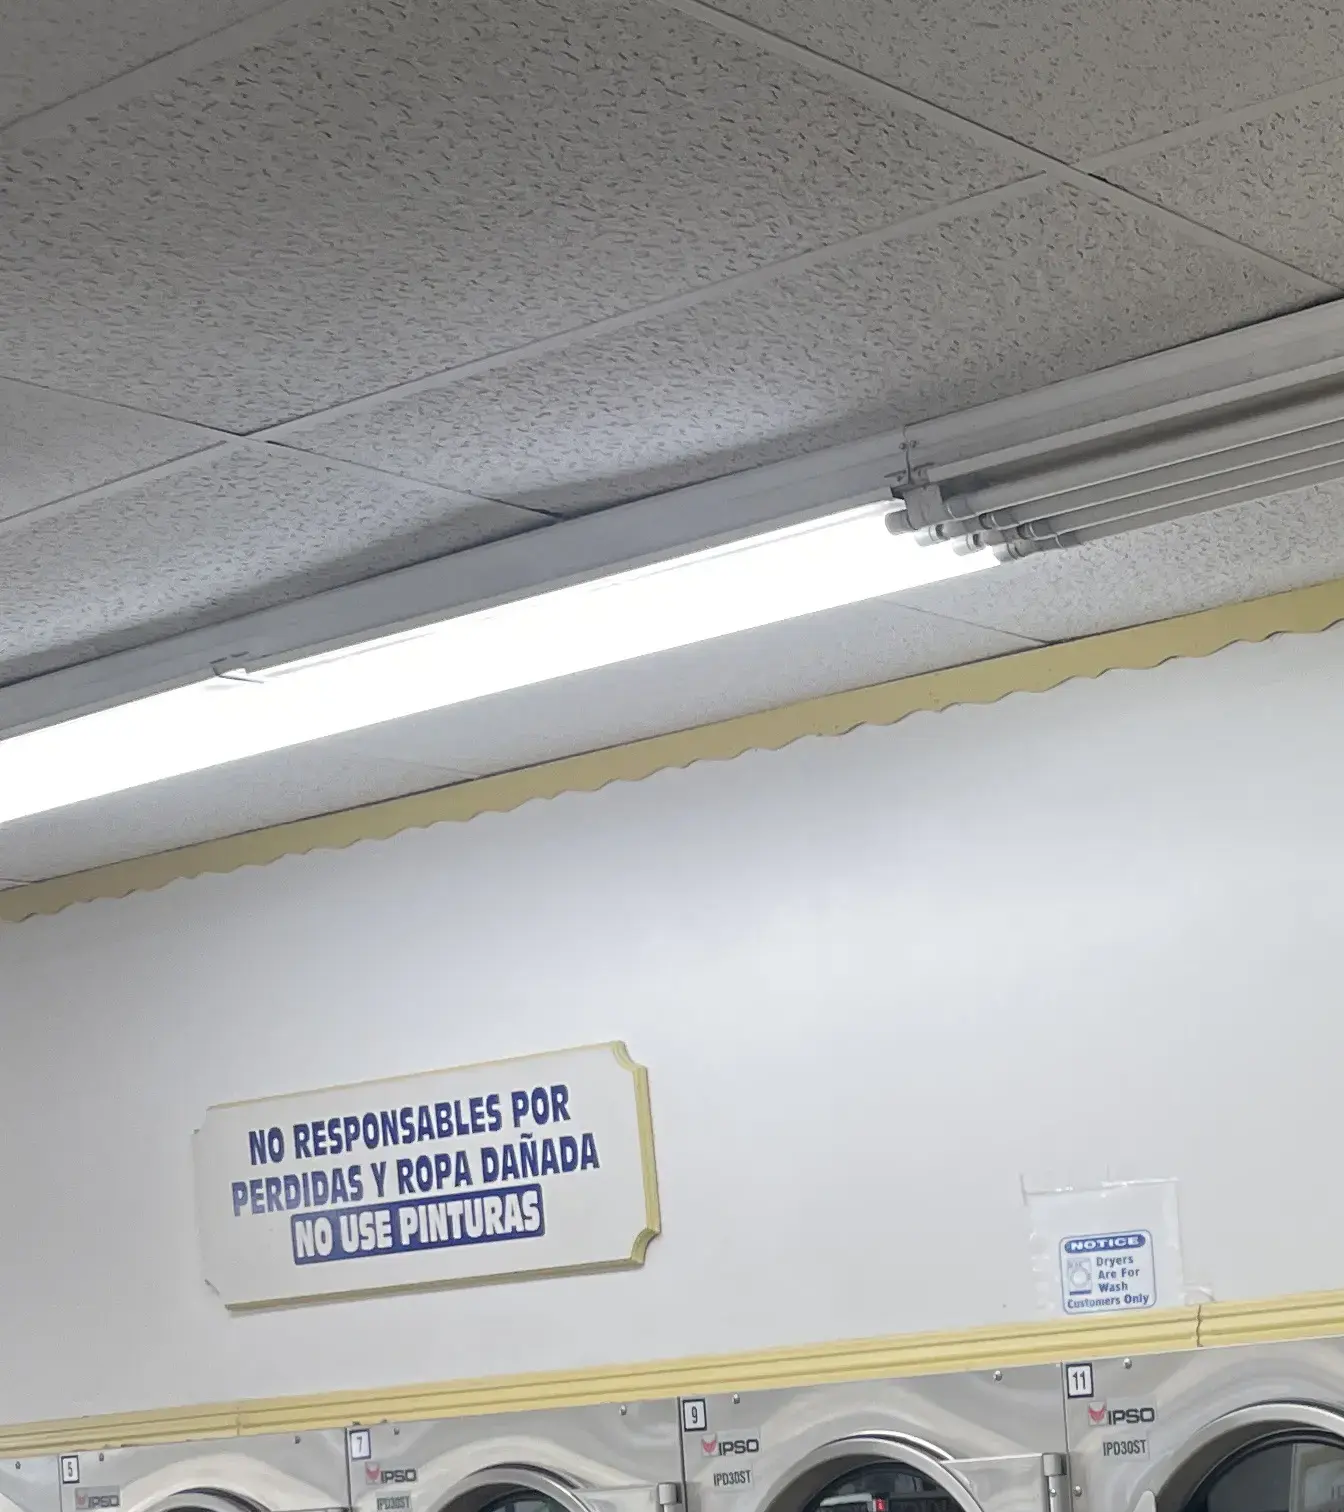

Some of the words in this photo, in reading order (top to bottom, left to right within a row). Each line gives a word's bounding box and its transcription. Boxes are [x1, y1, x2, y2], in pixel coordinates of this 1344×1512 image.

[248, 1127, 285, 1166] NO
[293, 1093, 501, 1160] RESPONSABLES
[510, 1084, 571, 1129] POR
[231, 1165, 364, 1217] PERDIDAS
[370, 1161, 388, 1198] Y
[396, 1148, 473, 1195] ROPA
[481, 1132, 600, 1184] DAÑADA
[296, 1219, 333, 1259] NO
[341, 1210, 393, 1253] USE
[400, 1191, 541, 1248] PINTURAS
[1070, 1236, 1140, 1251] NOTICE
[1096, 1255, 1134, 1268] Dryers
[1098, 1270, 1117, 1280] Are
[1121, 1267, 1140, 1278] For
[1098, 1281, 1128, 1293] Wash
[1067, 1295, 1121, 1309] Customers
[1124, 1293, 1149, 1305] Only
[1072, 1370, 1086, 1391] 11
[691, 1406, 699, 1424] 9
[1107, 1408, 1155, 1425] IPSO
[356, 1436, 363, 1453] 7
[718, 1438, 760, 1456] IPSO
[1103, 1439, 1146, 1457] IPD30ST
[67, 1461, 73, 1477] 5
[381, 1469, 417, 1483] IPSO
